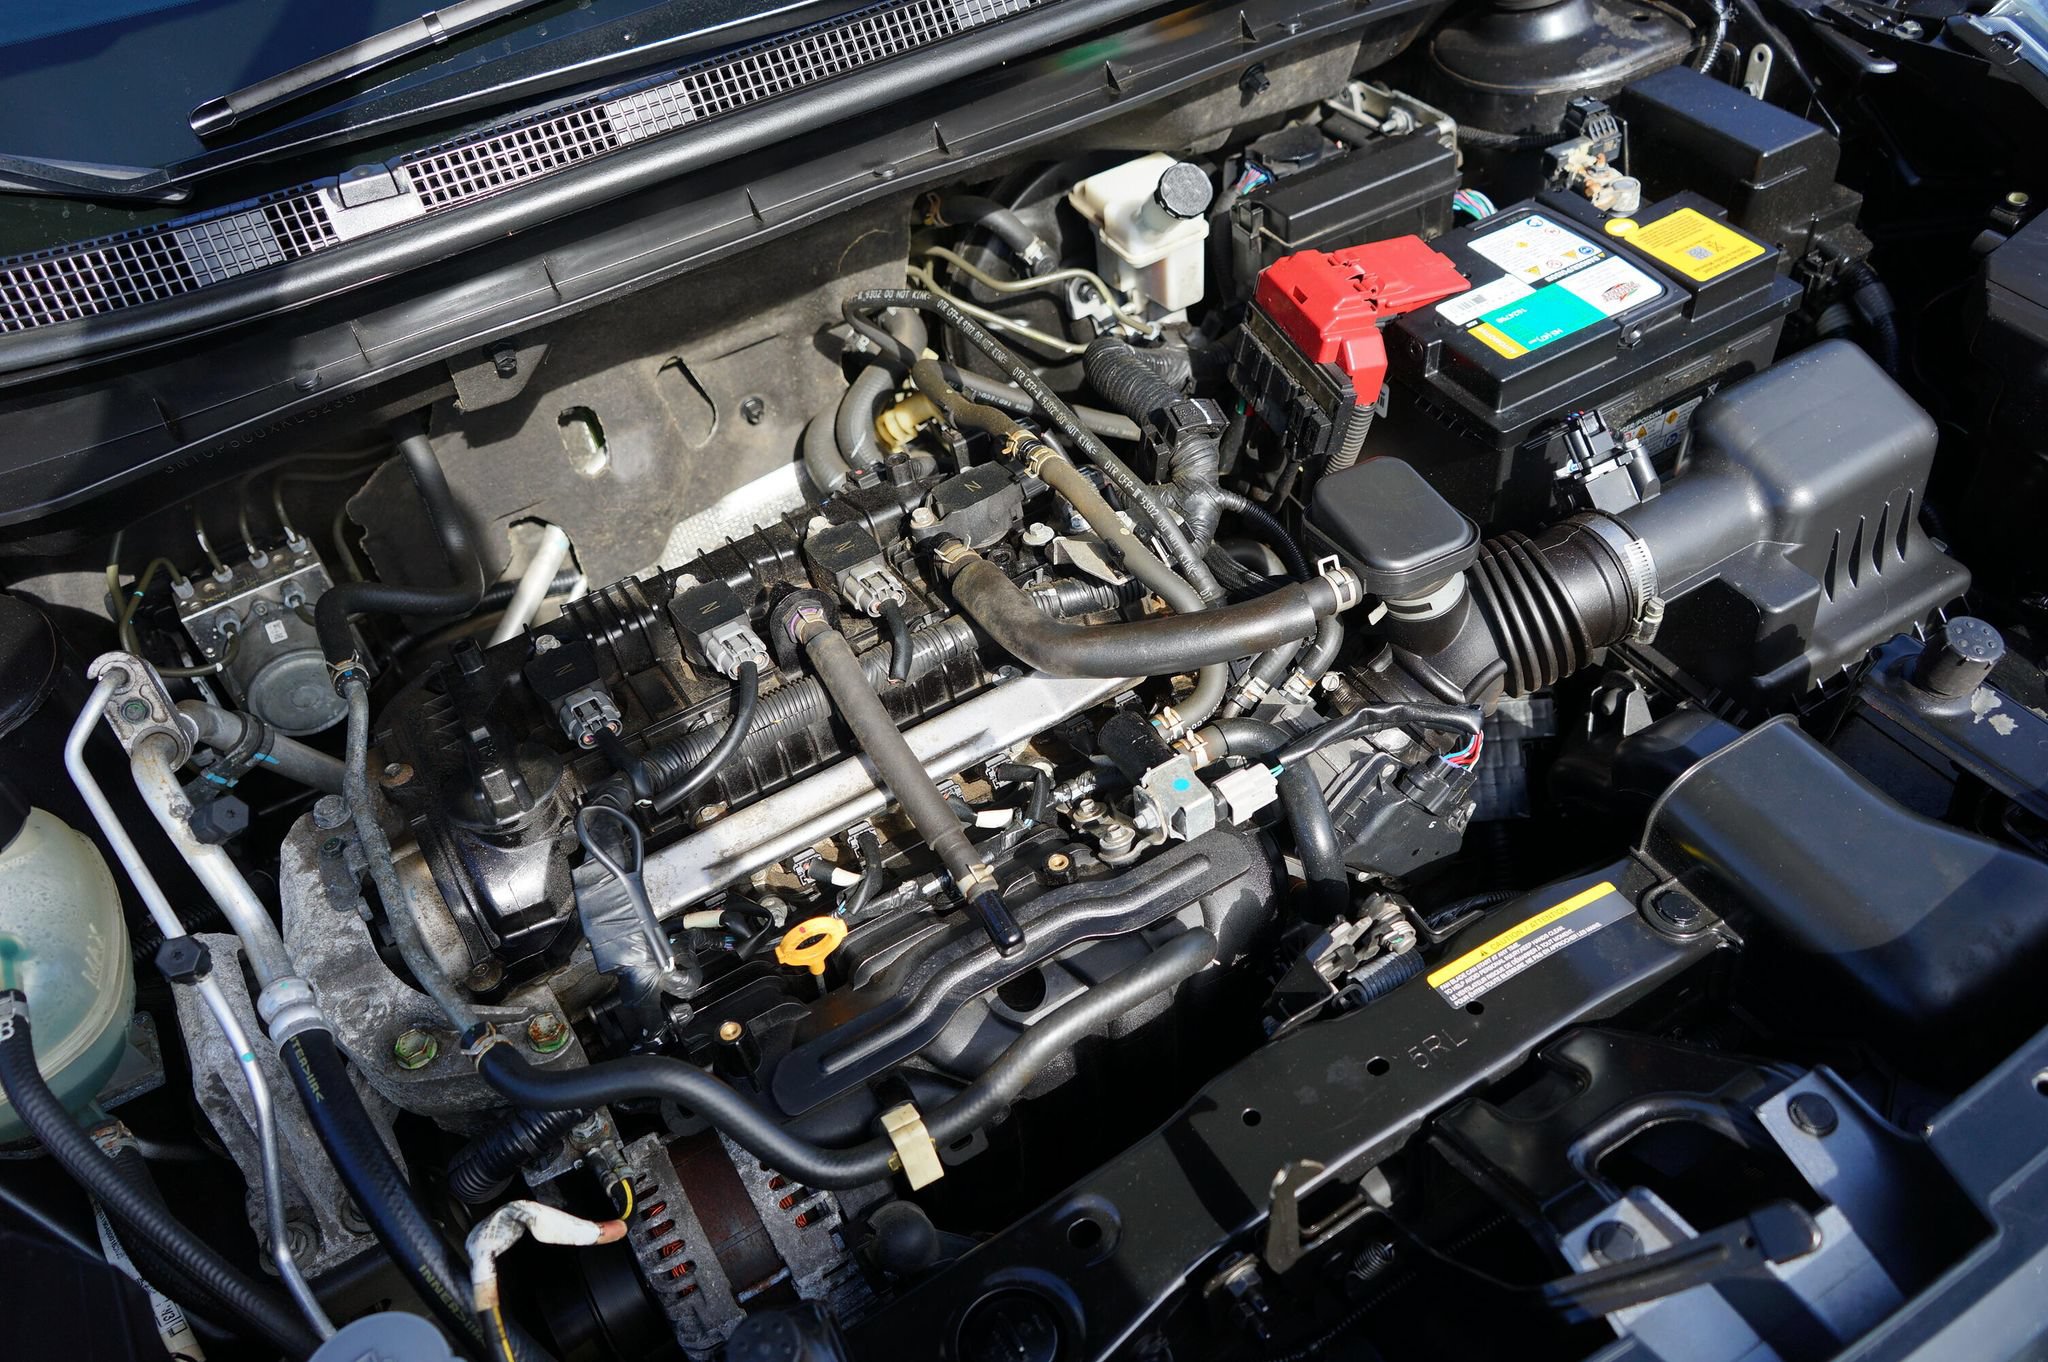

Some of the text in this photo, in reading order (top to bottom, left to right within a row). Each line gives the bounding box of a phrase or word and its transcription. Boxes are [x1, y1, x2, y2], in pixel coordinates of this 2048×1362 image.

[895, 290, 910, 298] NOT
[980, 338, 993, 352] NOT
[1064, 422, 1078, 436] NOT
[1138, 496, 1159, 519] 9302
[1490, 932, 1524, 950] CAUTION
[1530, 907, 1569, 928] ATTENTION
[1439, 981, 1451, 990] FAN
[1465, 966, 1477, 975] CAN
[1407, 1029, 1468, 1068] 5RL
